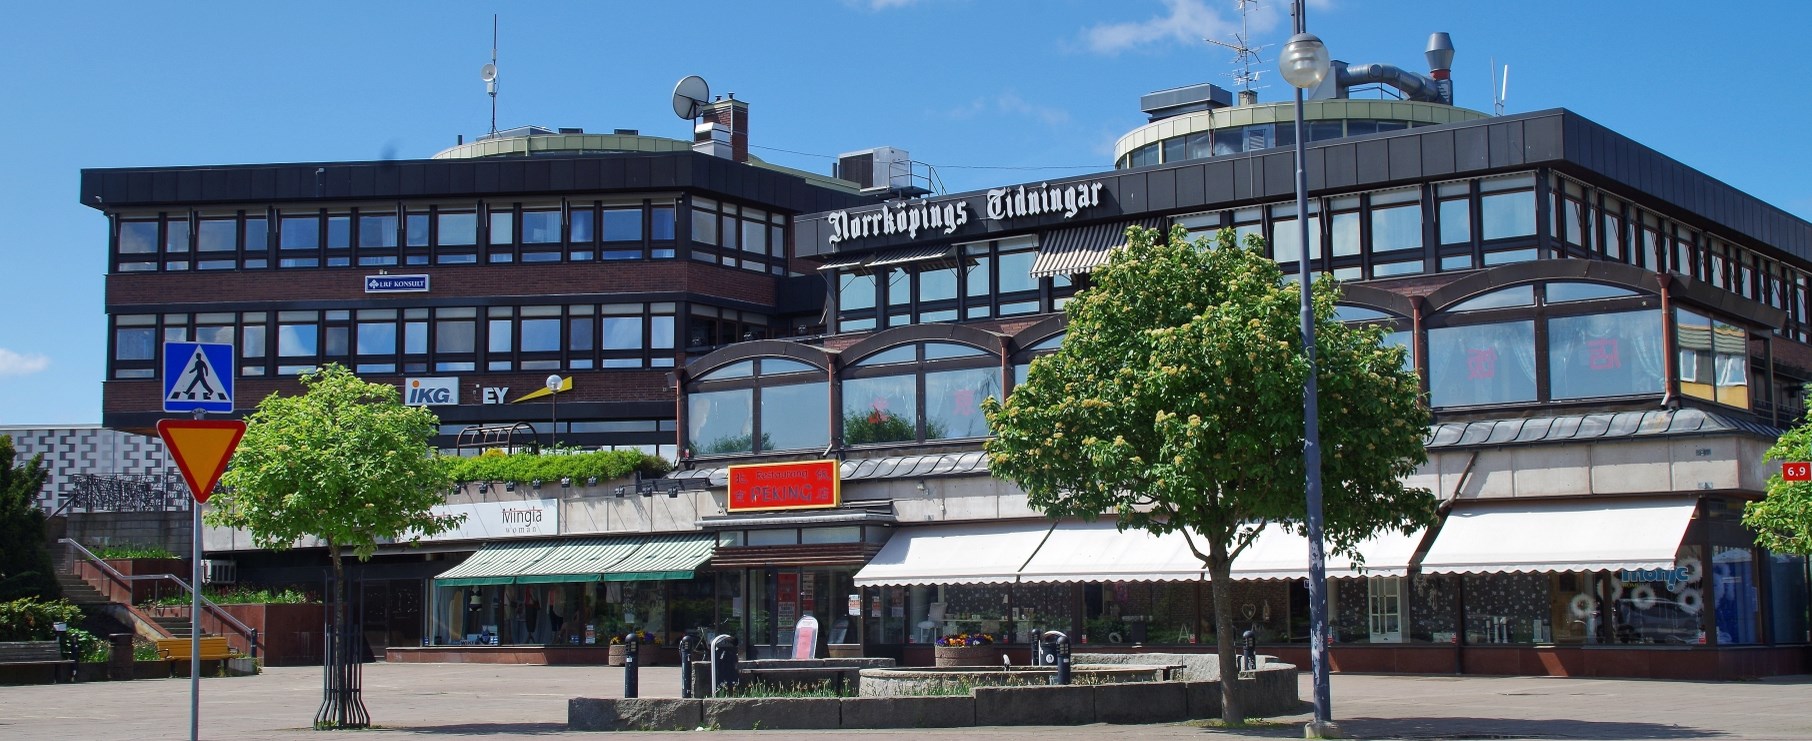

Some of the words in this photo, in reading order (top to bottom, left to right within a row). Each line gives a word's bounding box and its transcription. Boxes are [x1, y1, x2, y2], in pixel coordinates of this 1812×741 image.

[828, 199, 967, 245] Norrköpings
[987, 181, 1103, 219] Tidningar
[394, 280, 424, 288] KONSULT
[483, 387, 509, 405] EY
[750, 483, 813, 502] PEKING
[502, 506, 542, 527] Mingla
